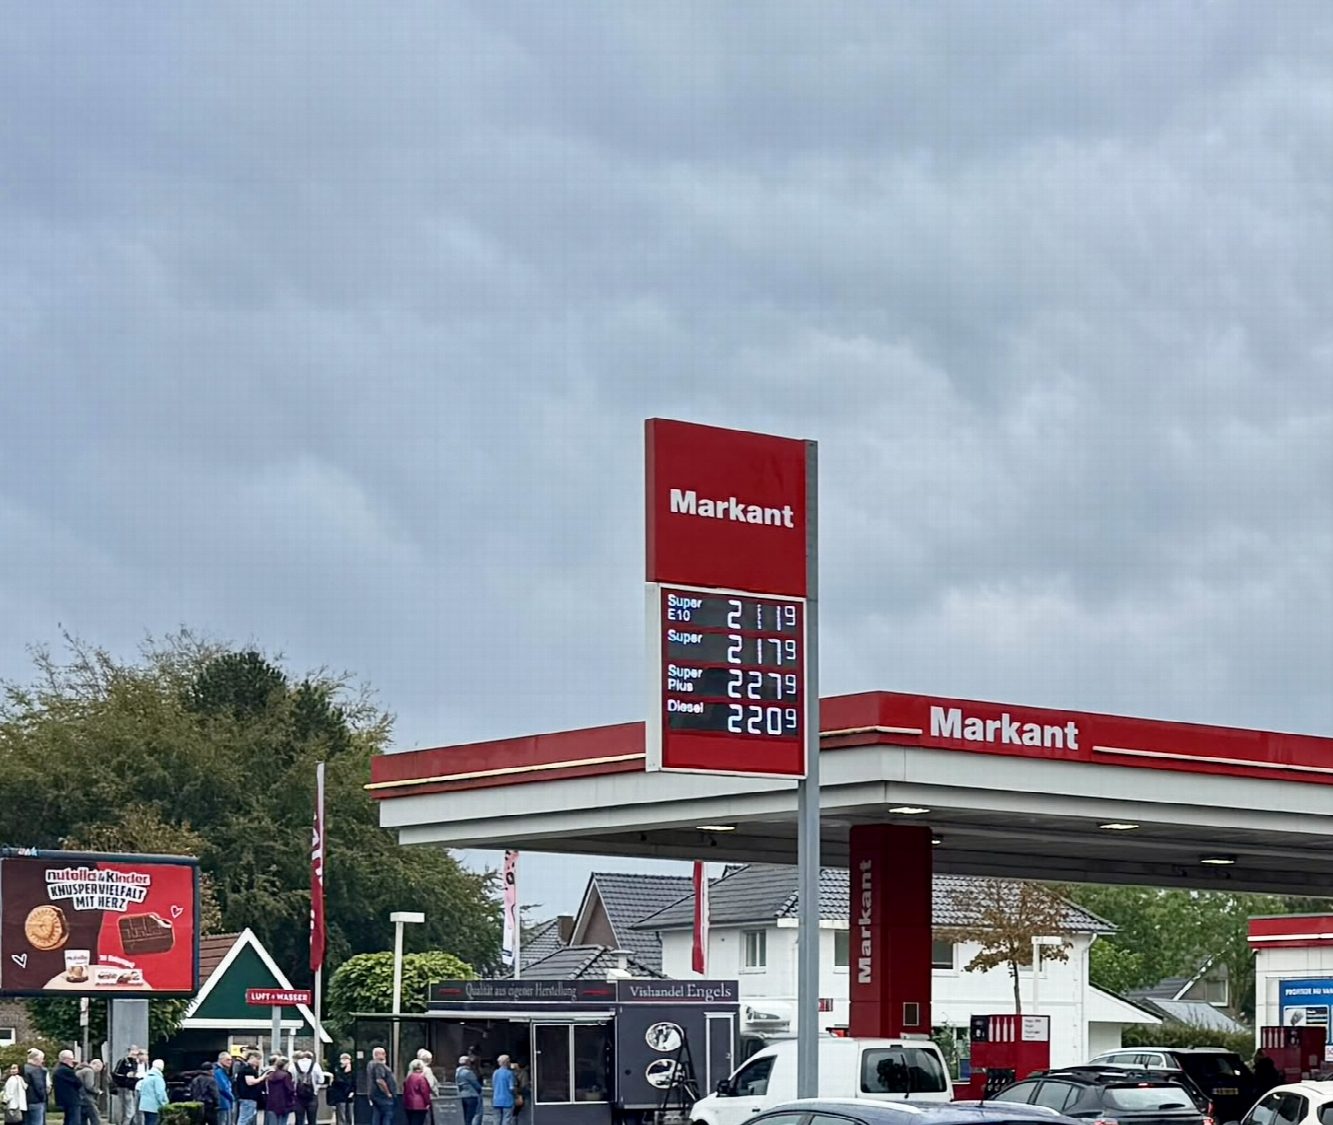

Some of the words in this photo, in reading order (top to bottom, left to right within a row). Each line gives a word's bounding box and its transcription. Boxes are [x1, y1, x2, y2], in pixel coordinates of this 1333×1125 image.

[670, 488, 794, 528] Markant
[668, 594, 702, 608] Super
[668, 608, 690, 621] E10
[668, 629, 703, 645] Super
[668, 664, 703, 679] Super
[668, 678, 694, 692] Plus
[667, 699, 704, 714] Diesel
[930, 706, 1079, 750] Markant
[76, 896, 94, 908] MIT
[98, 896, 126, 909] HERZ
[858, 860, 871, 983] Markant
[251, 992, 270, 1001] LUFT
[466, 982, 493, 1000] Qualität
[495, 988, 506, 997] aus
[508, 983, 533, 1001] eigener
[535, 982, 577, 1002] Herstellung
[630, 986, 684, 997] Vishandel
[687, 983, 731, 1001] Engels
